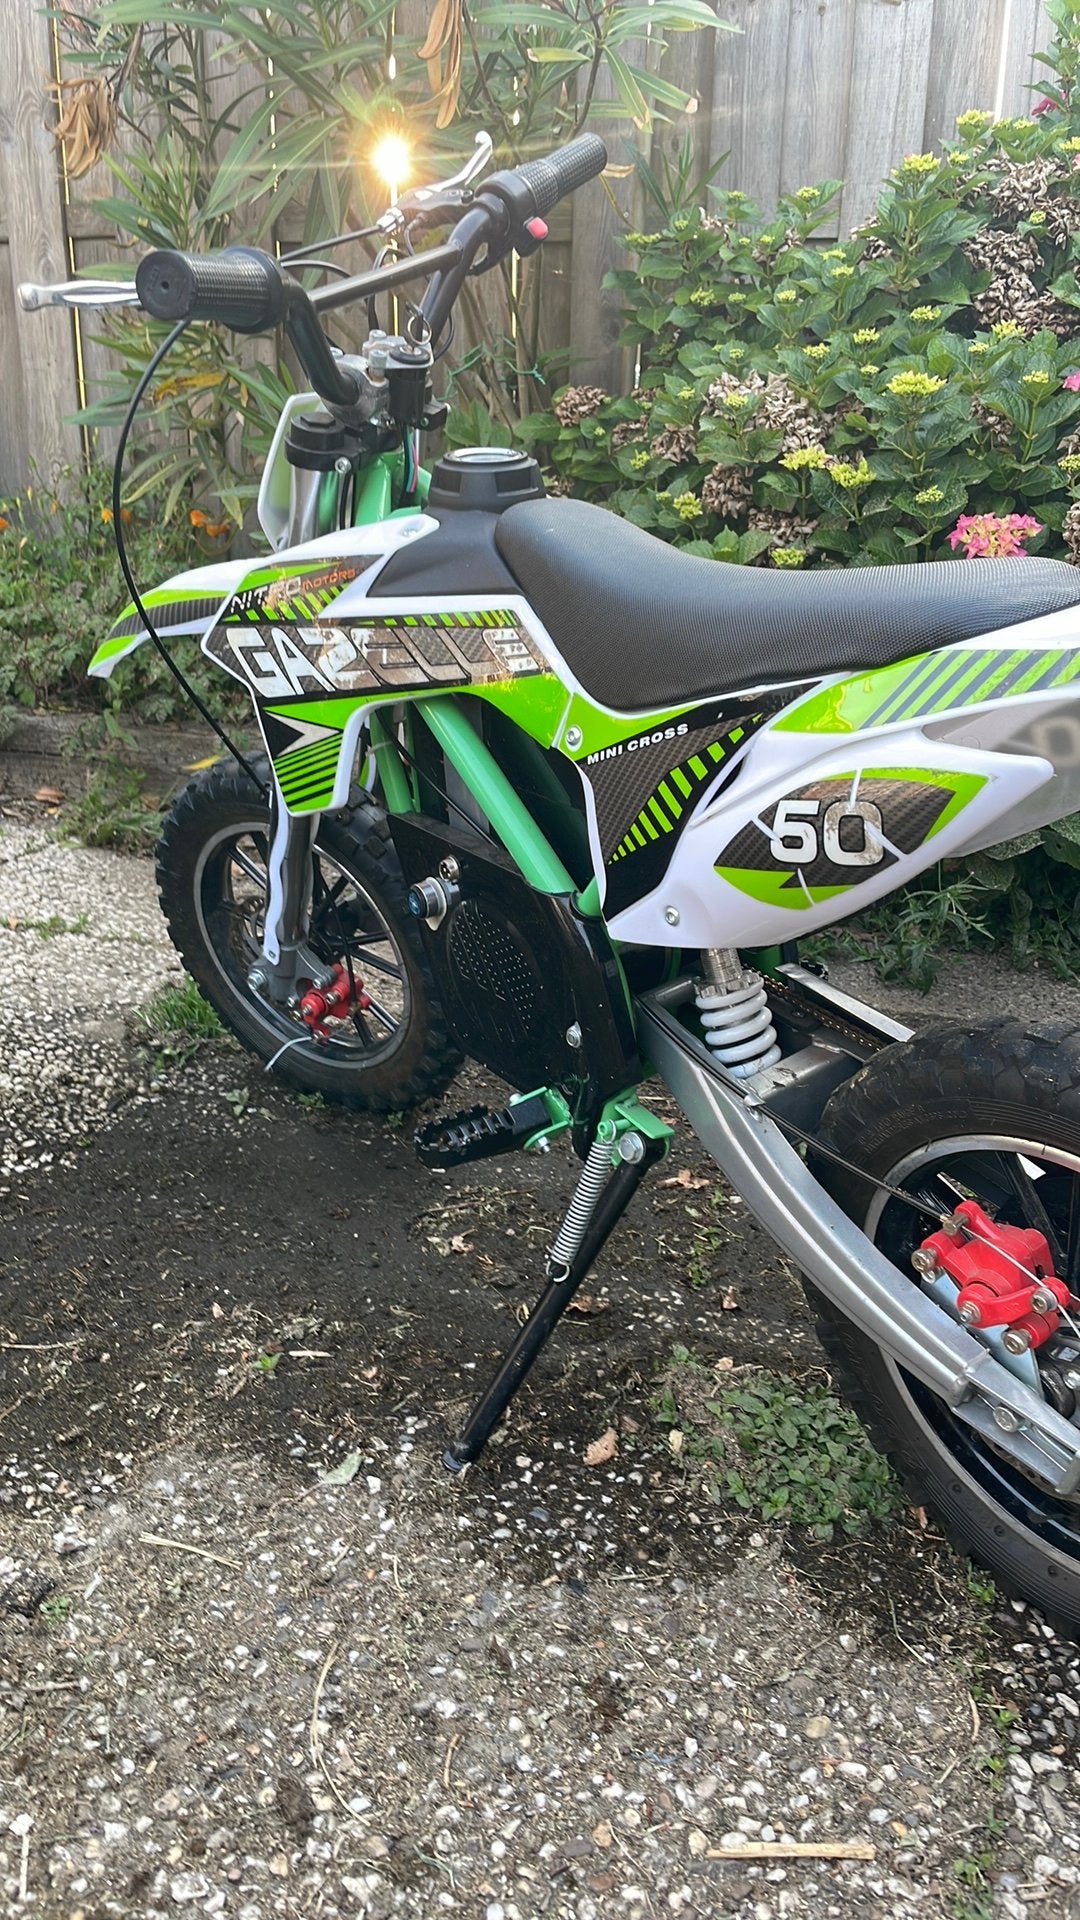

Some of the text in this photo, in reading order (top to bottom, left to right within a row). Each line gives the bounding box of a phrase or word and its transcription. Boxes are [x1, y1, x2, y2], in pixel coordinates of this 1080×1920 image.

[230, 568, 356, 613] NITRO MOTORS
[226, 626, 541, 698] GAZELLE
[587, 723, 689, 765] MINI CROSS
[770, 800, 884, 866] 50
